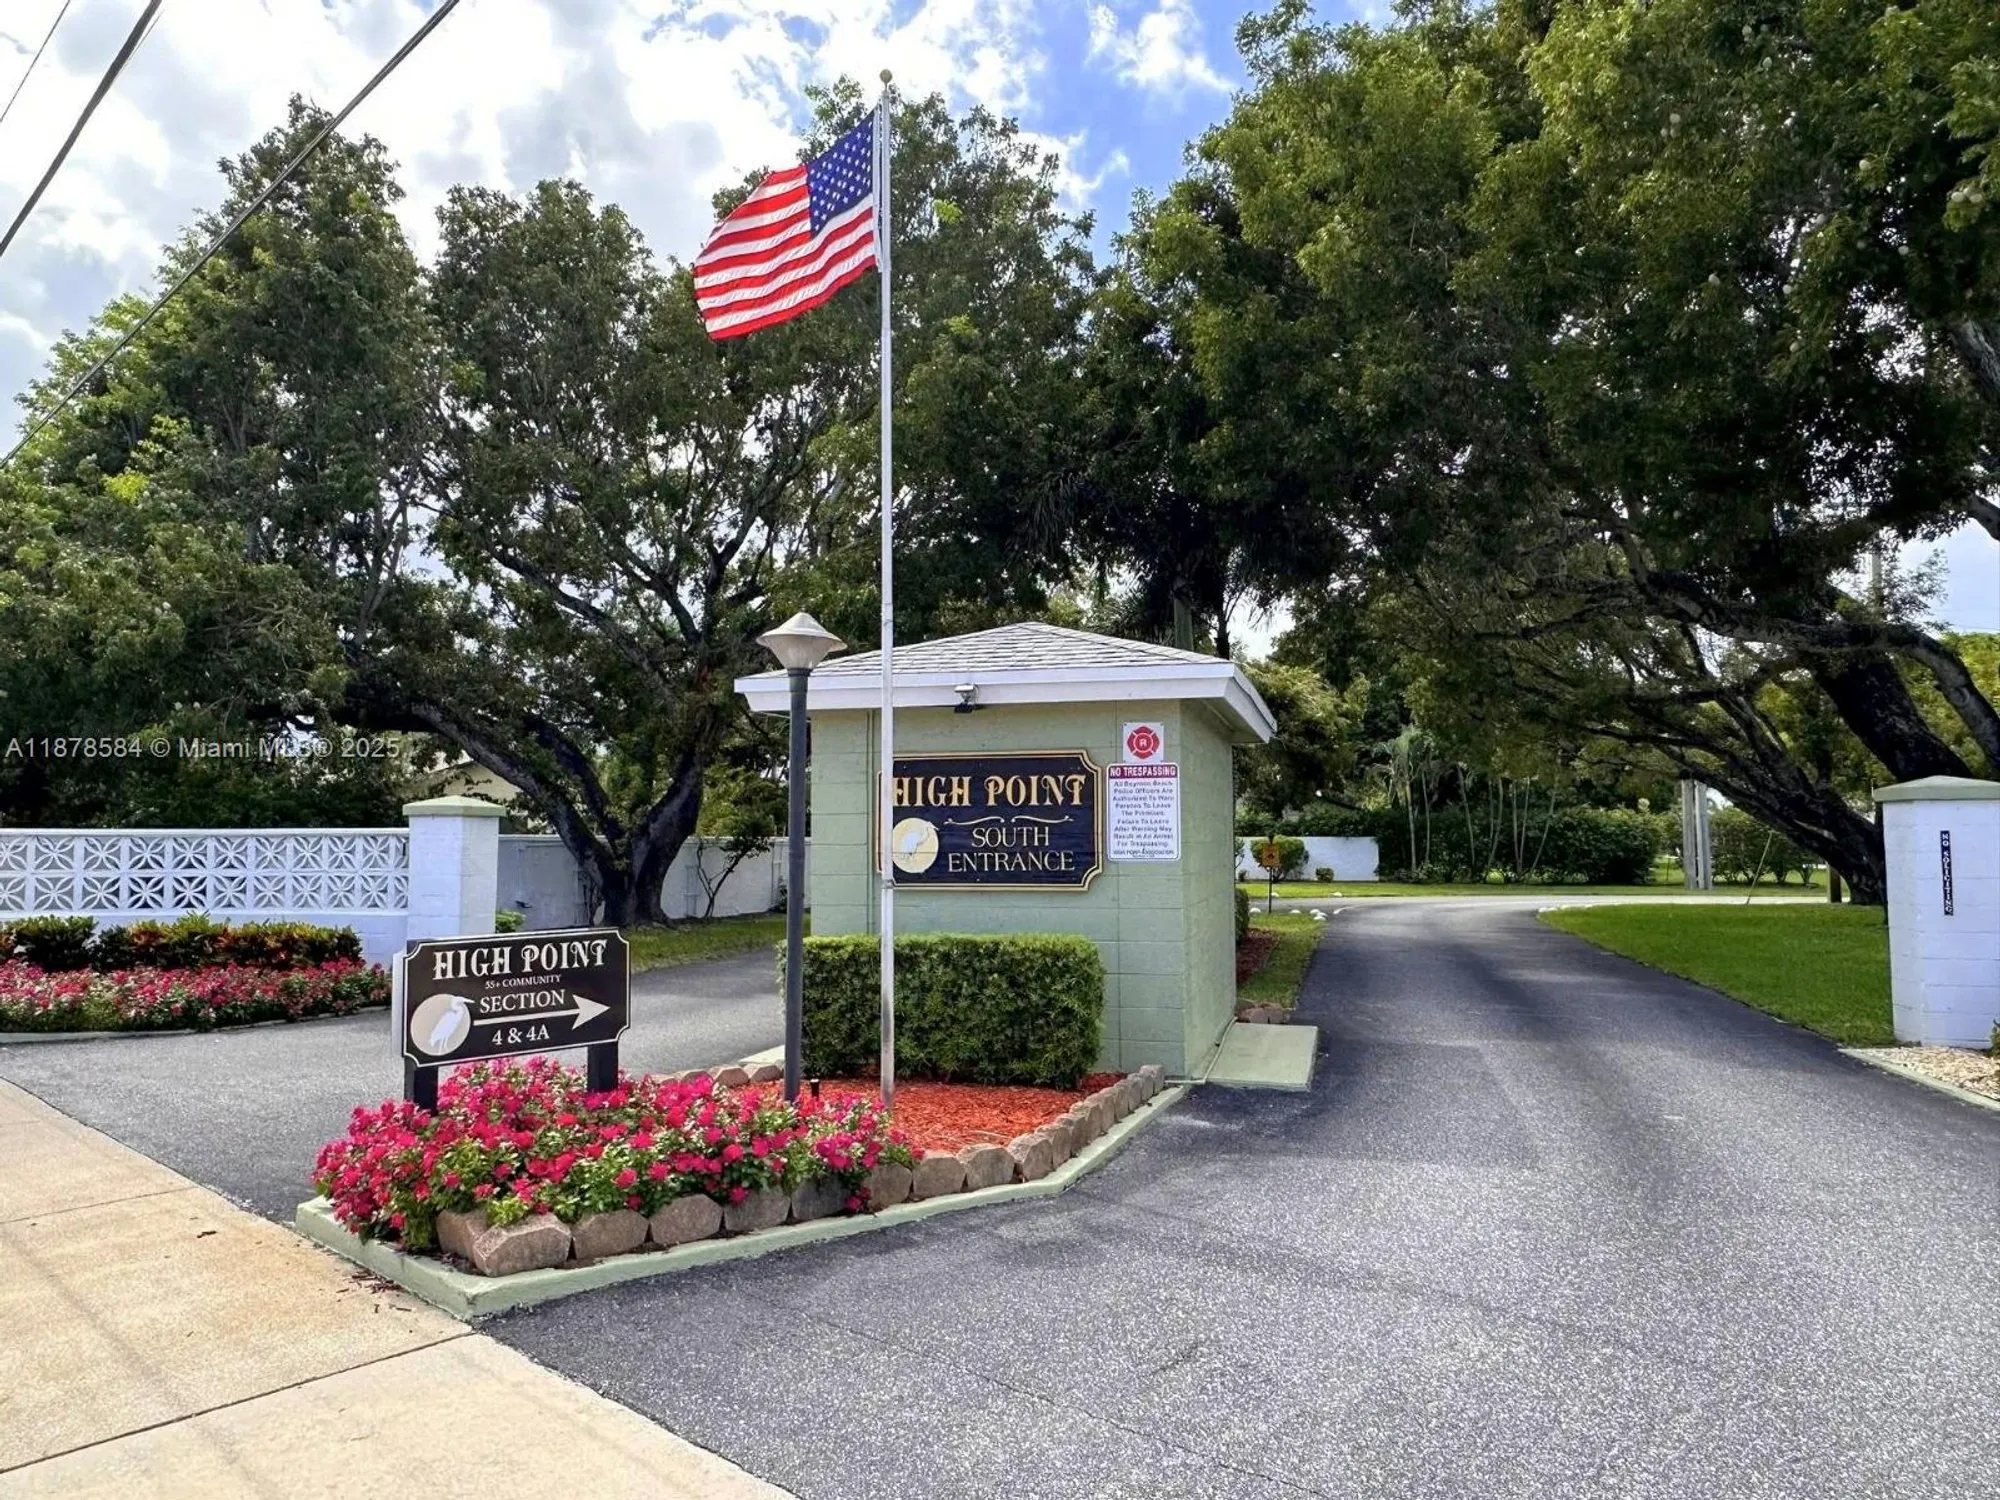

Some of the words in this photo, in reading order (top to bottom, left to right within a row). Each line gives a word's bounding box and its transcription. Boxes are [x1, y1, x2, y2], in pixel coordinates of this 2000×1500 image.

[1110, 768, 1121, 777] NO
[1123, 766, 1176, 776] TRESPASSING
[892, 775, 972, 807] HIGH
[984, 774, 1086, 807] POINT
[972, 826, 1049, 848] SOUTH
[1942, 833, 1949, 847] NO
[948, 850, 1075, 873] ENTRANCE
[1942, 851, 1953, 912] SOLICITING
[432, 946, 513, 980] HIGH
[520, 939, 607, 973] POINT
[485, 979, 501, 990] 55+
[502, 974, 562, 988] COMMUNITY
[480, 989, 566, 1014] SECTION
[492, 1030, 503, 1045] 4
[507, 1028, 522, 1044] &
[526, 1025, 550, 1041] 4A
